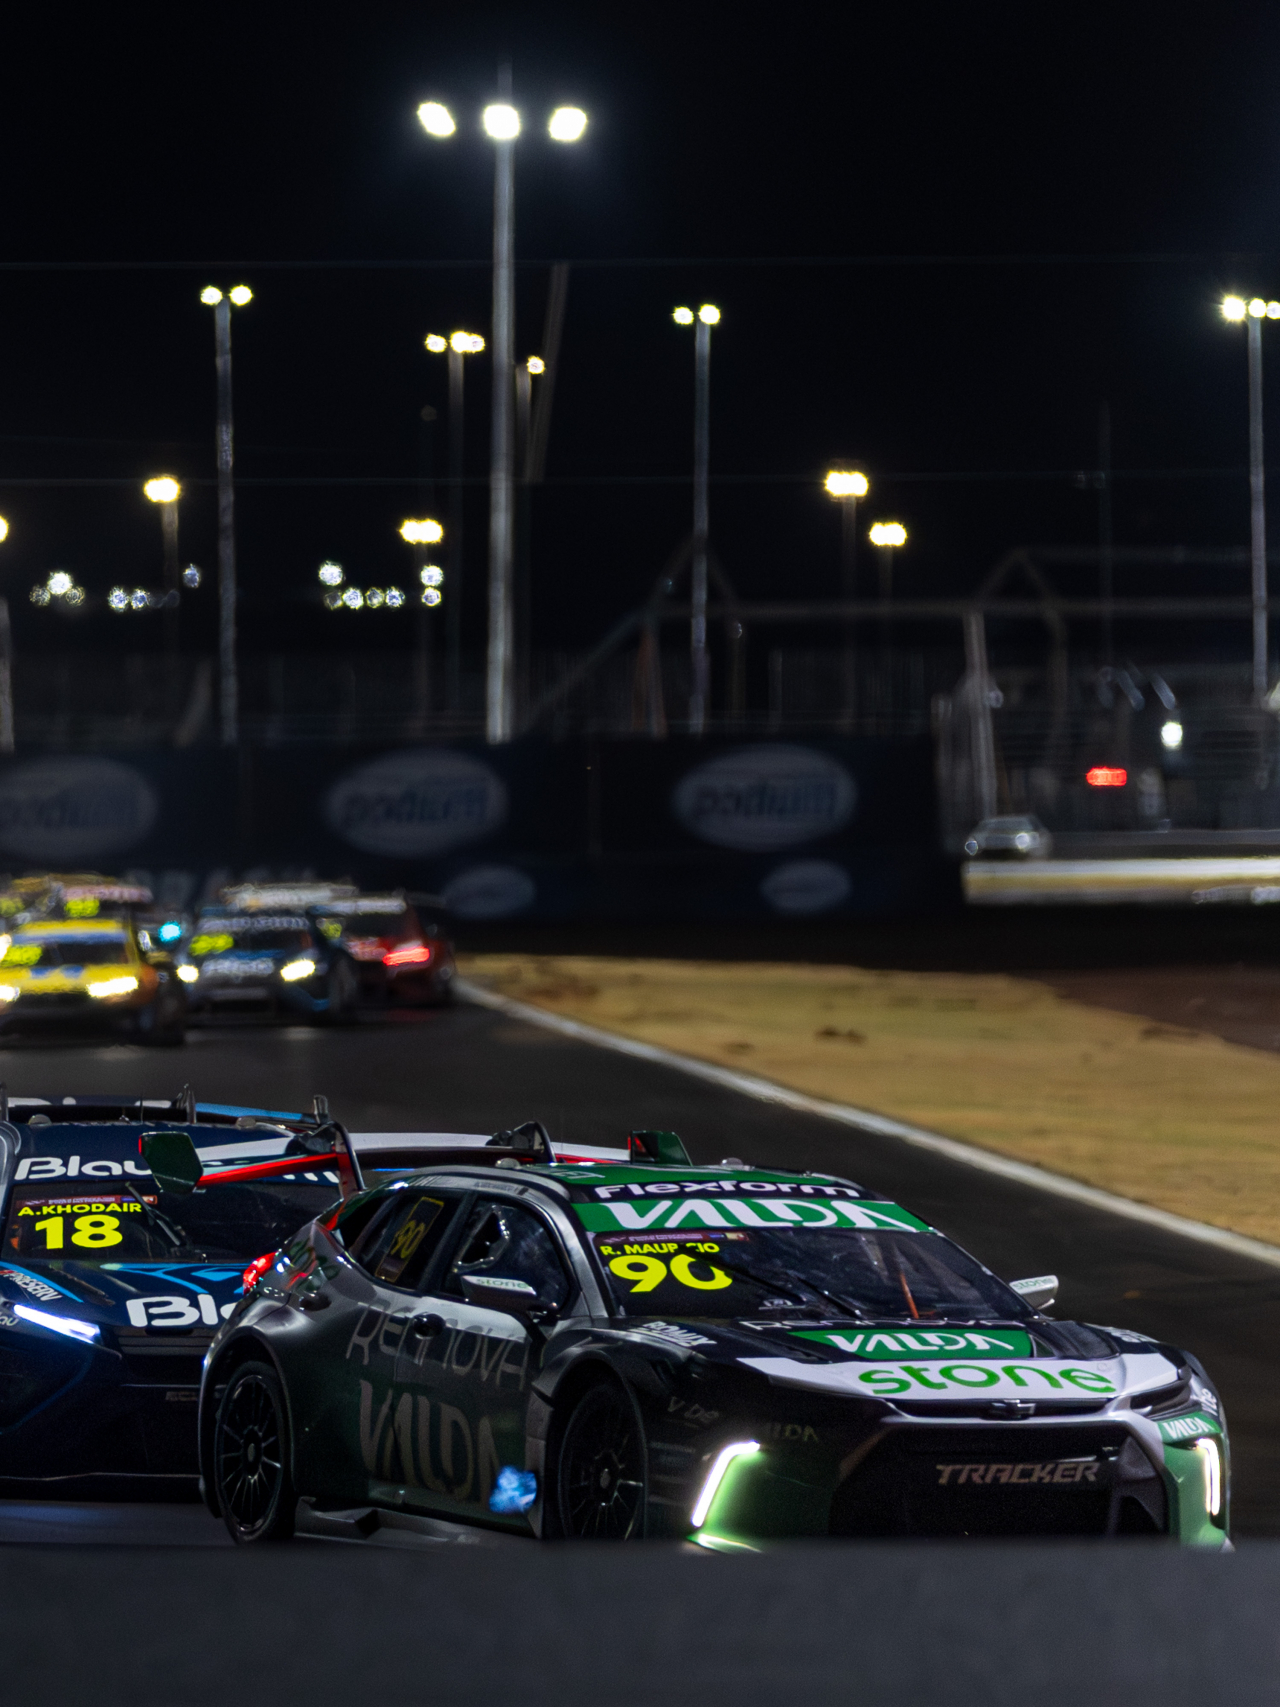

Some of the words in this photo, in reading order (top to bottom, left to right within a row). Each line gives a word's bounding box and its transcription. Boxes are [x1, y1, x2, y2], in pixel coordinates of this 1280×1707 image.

[14, 1155, 153, 1181] Blau
[595, 1180, 860, 1199] Flexform
[599, 1199, 921, 1233] VALDA
[35, 1214, 123, 1249] 18
[600, 1245, 621, 1256] R.
[609, 1254, 733, 1293] 90
[126, 1294, 238, 1327] Bl
[825, 1332, 1014, 1353] VALDA
[859, 1365, 1117, 1395] stone
[1162, 1417, 1216, 1440] VALDA
[936, 1462, 1101, 1485] TRACKER
